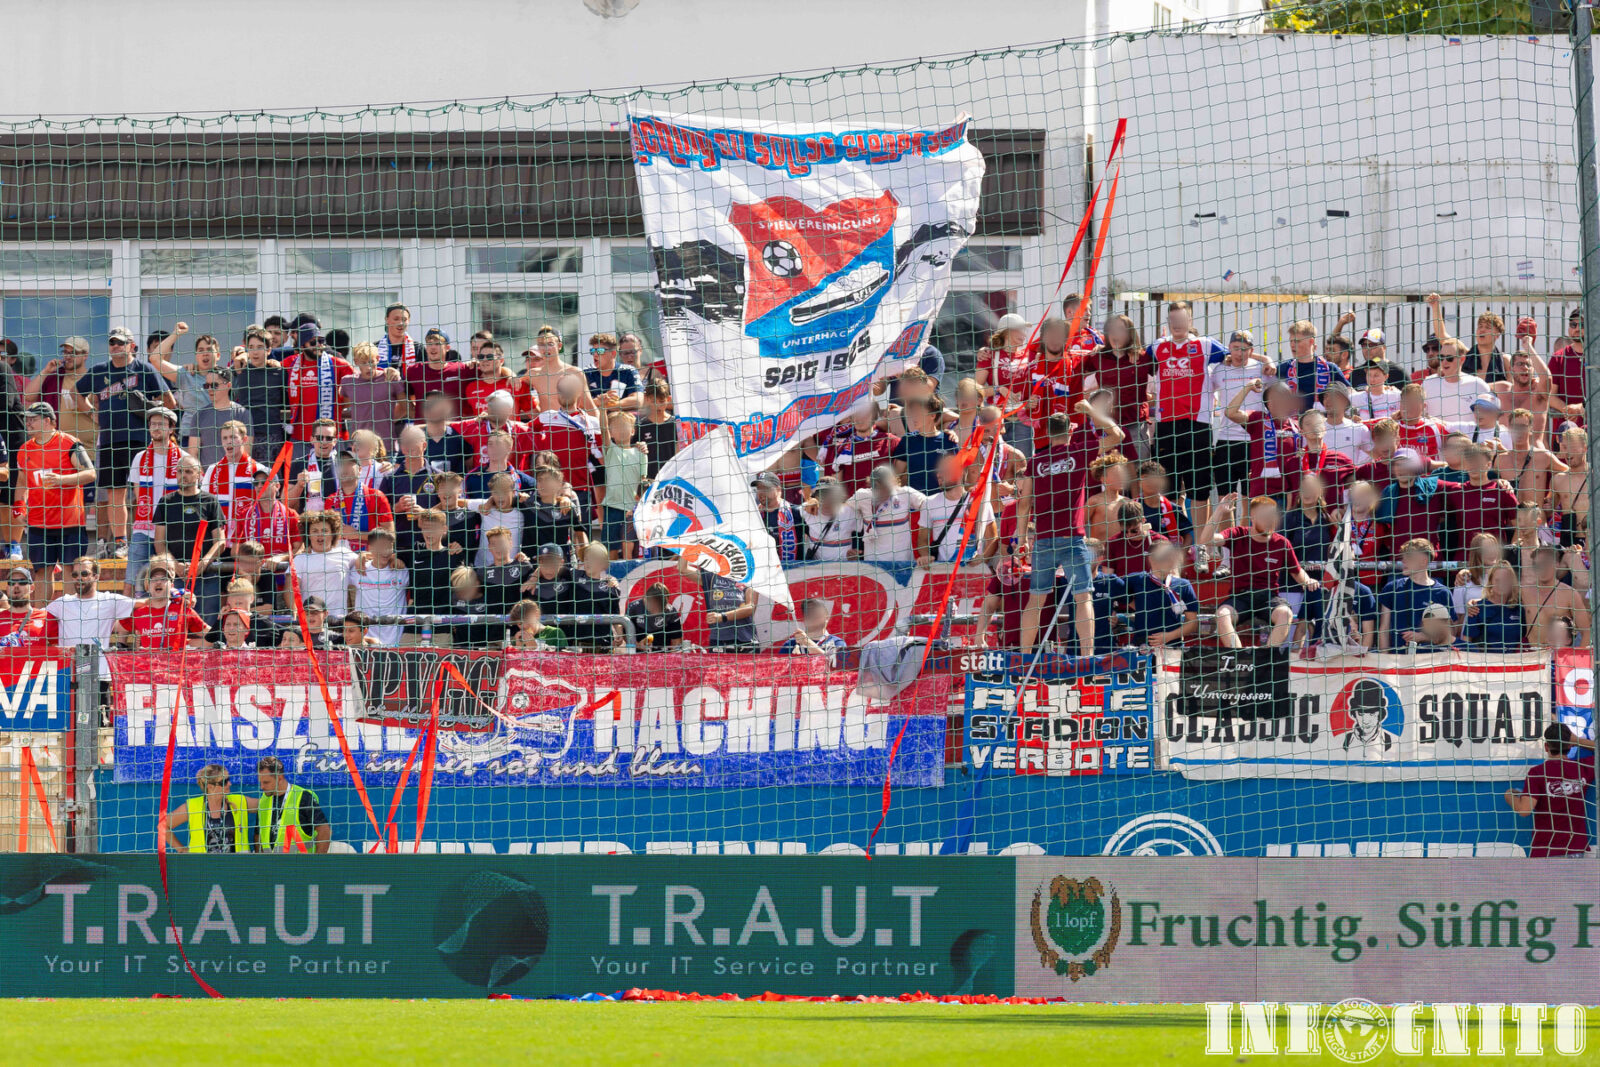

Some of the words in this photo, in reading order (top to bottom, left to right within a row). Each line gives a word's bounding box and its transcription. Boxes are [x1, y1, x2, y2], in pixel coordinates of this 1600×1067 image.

[759, 214, 881, 231] SPIELVEREINIGUNG
[960, 651, 1004, 671] statt
[972, 687, 1148, 713] ALLE
[1190, 684, 1272, 705] Unvergessen
[970, 715, 1149, 741] STADION
[1419, 692, 1543, 748] SQUAD
[548, 745, 617, 776] und
[629, 745, 701, 778] blau
[969, 745, 1150, 769] VERBOTE
[44, 884, 391, 944] T.R.A.U.T
[591, 885, 940, 947] T.R.A.U.T
[1126, 899, 1378, 962] Fruchtig.
[1397, 899, 1557, 963] Süffig
[44, 955, 103, 974] Your
[124, 955, 146, 974] IT
[167, 954, 266, 975] Service
[289, 954, 391, 975] Partner
[591, 956, 650, 976] Your
[671, 956, 693, 976] IT
[713, 955, 814, 976] Service
[836, 955, 940, 976] Partner
